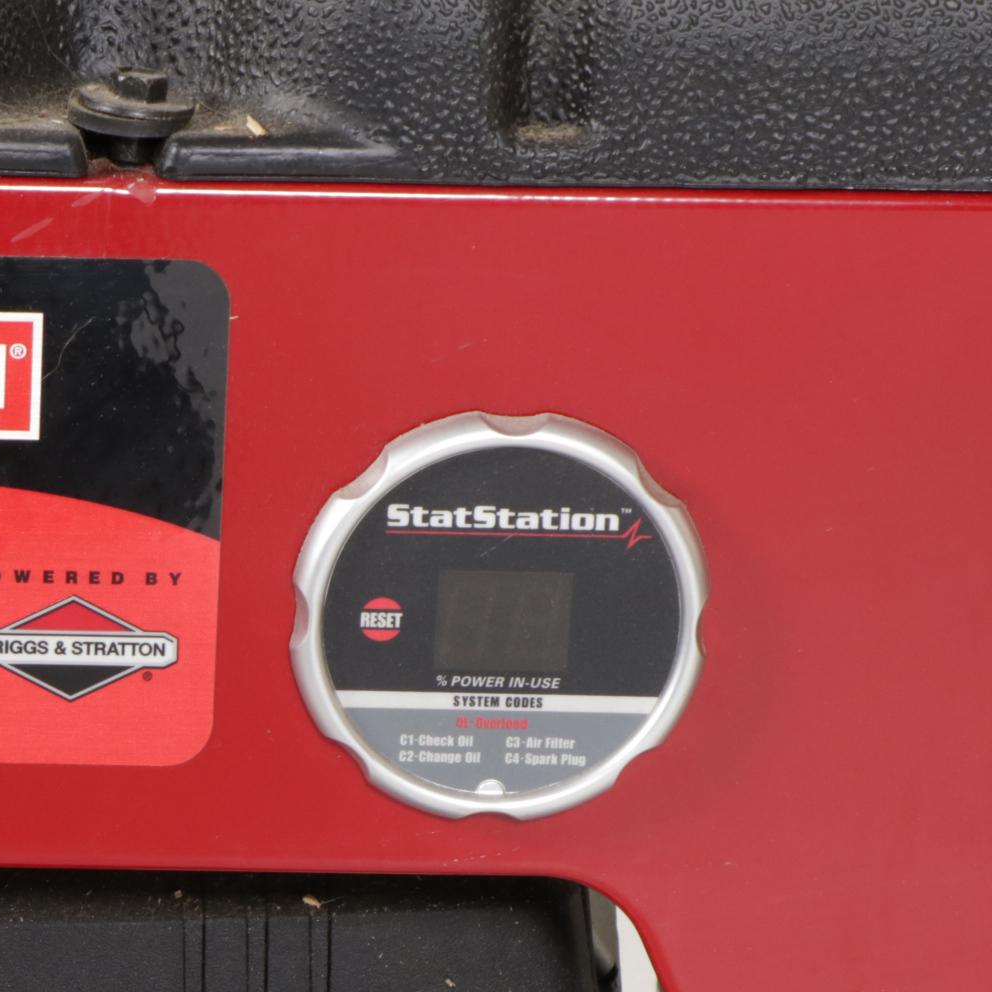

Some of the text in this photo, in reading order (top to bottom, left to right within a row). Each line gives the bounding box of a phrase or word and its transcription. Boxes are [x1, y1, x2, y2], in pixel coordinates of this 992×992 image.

[145, 572, 182, 586] BY
[360, 610, 403, 629] RESET
[54, 641, 67, 655] &
[71, 642, 166, 656] STRATTON
[450, 676, 506, 688] POWER
[508, 677, 561, 689] IN-USE
[453, 696, 543, 708] SYSTEM CODES
[458, 736, 474, 747] Oil
[545, 737, 575, 749] Filter
[465, 752, 481, 763] Oil
[561, 754, 586, 767] Plug
